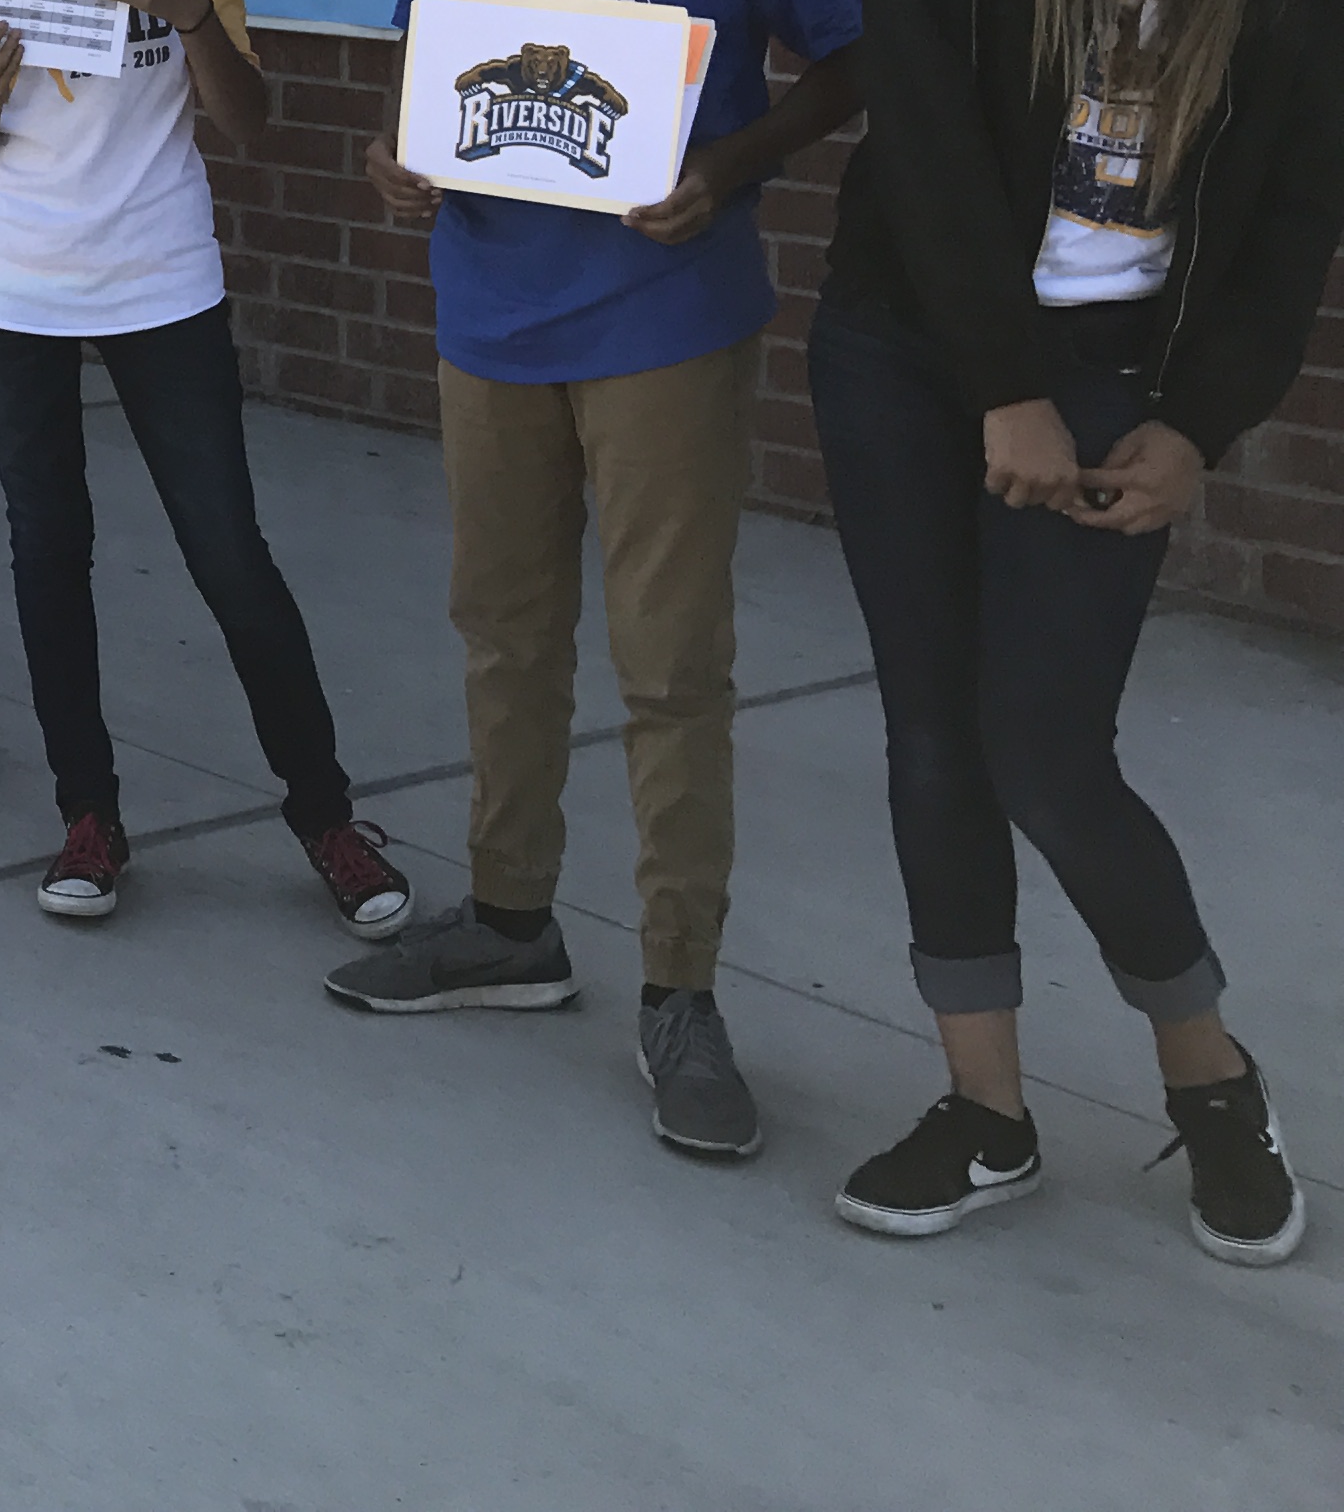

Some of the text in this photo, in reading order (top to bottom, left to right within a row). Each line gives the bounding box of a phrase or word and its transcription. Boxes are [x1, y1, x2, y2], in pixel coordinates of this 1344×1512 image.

[133, 45, 170, 69] 2018
[458, 90, 613, 171] RIVERSIDE
[494, 131, 578, 156] HIGHLANDERS
